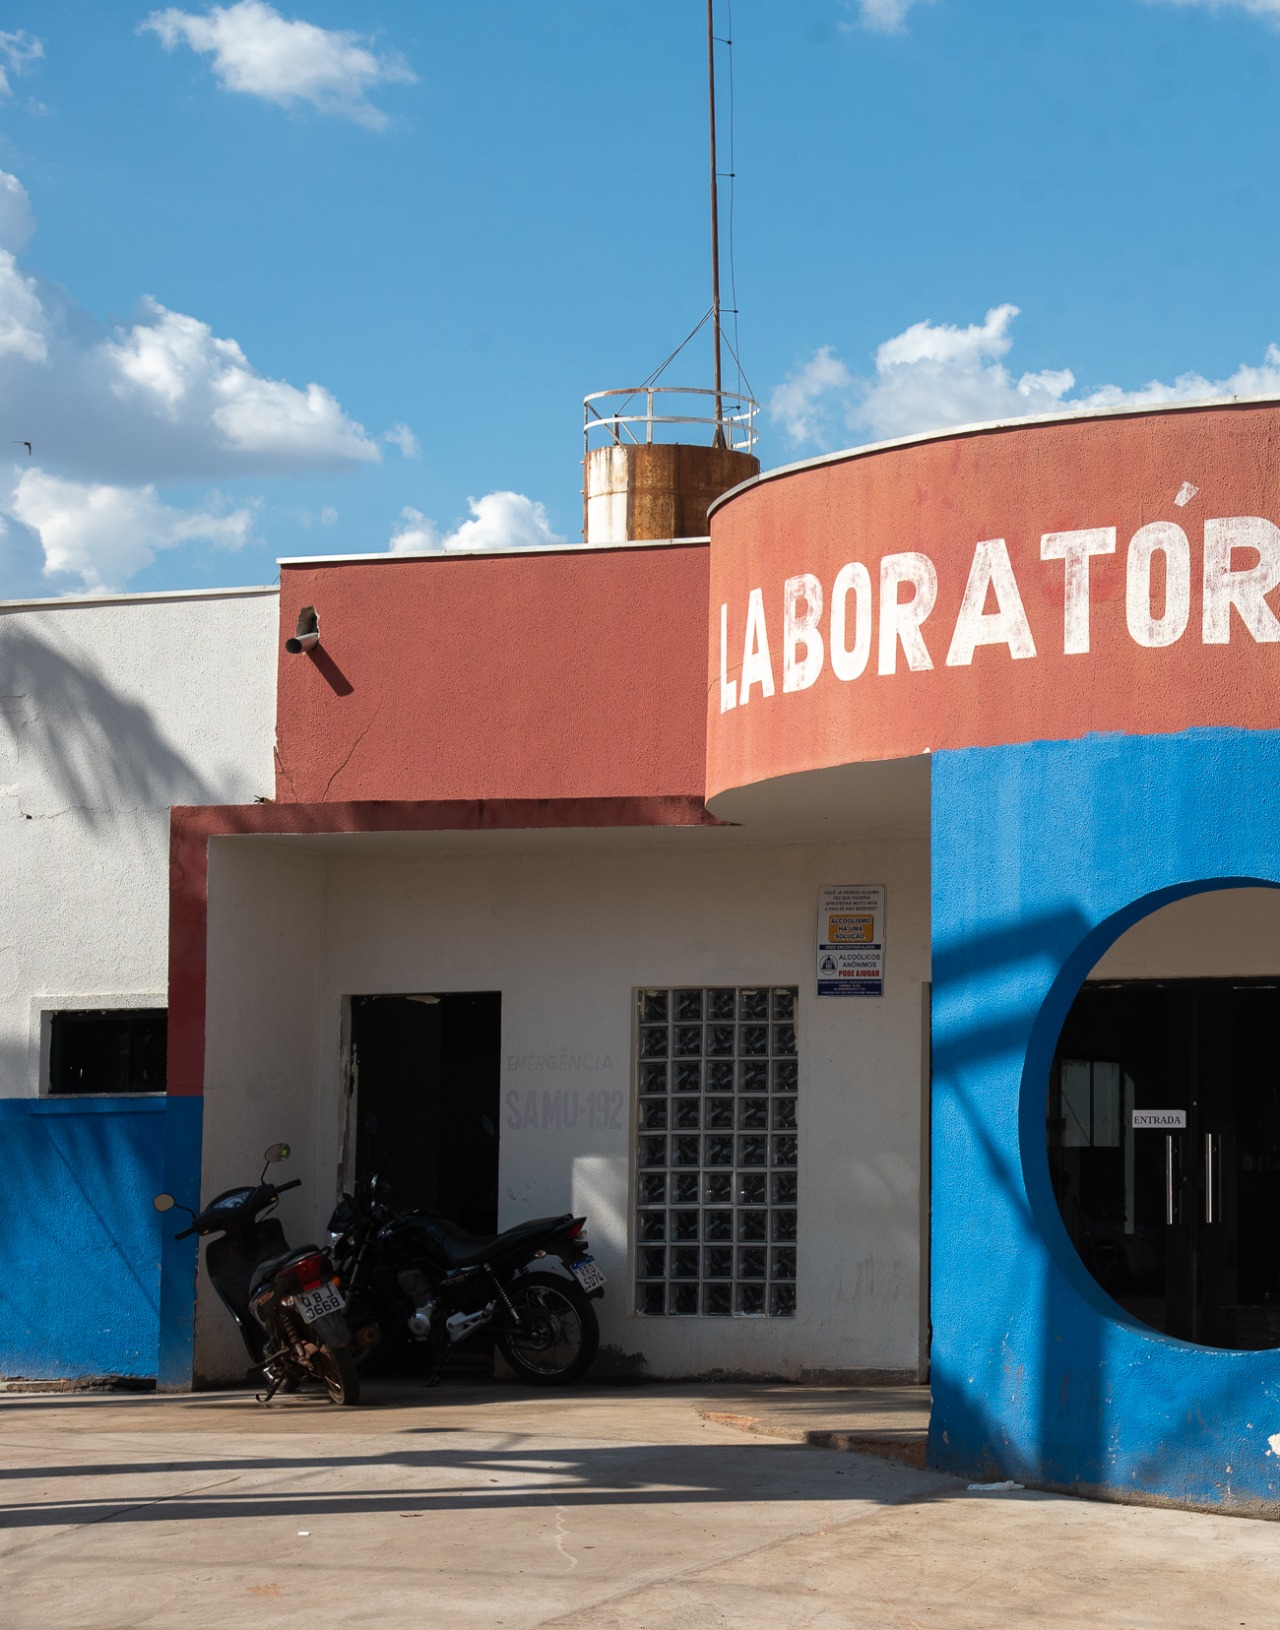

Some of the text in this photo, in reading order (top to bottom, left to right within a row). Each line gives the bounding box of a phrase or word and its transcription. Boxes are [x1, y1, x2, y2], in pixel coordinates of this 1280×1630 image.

[507, 1046, 613, 1071] EMERGÊNCIA
[1134, 1115, 1181, 1124] ENTRADA
[301, 1284, 334, 1307] QBJ
